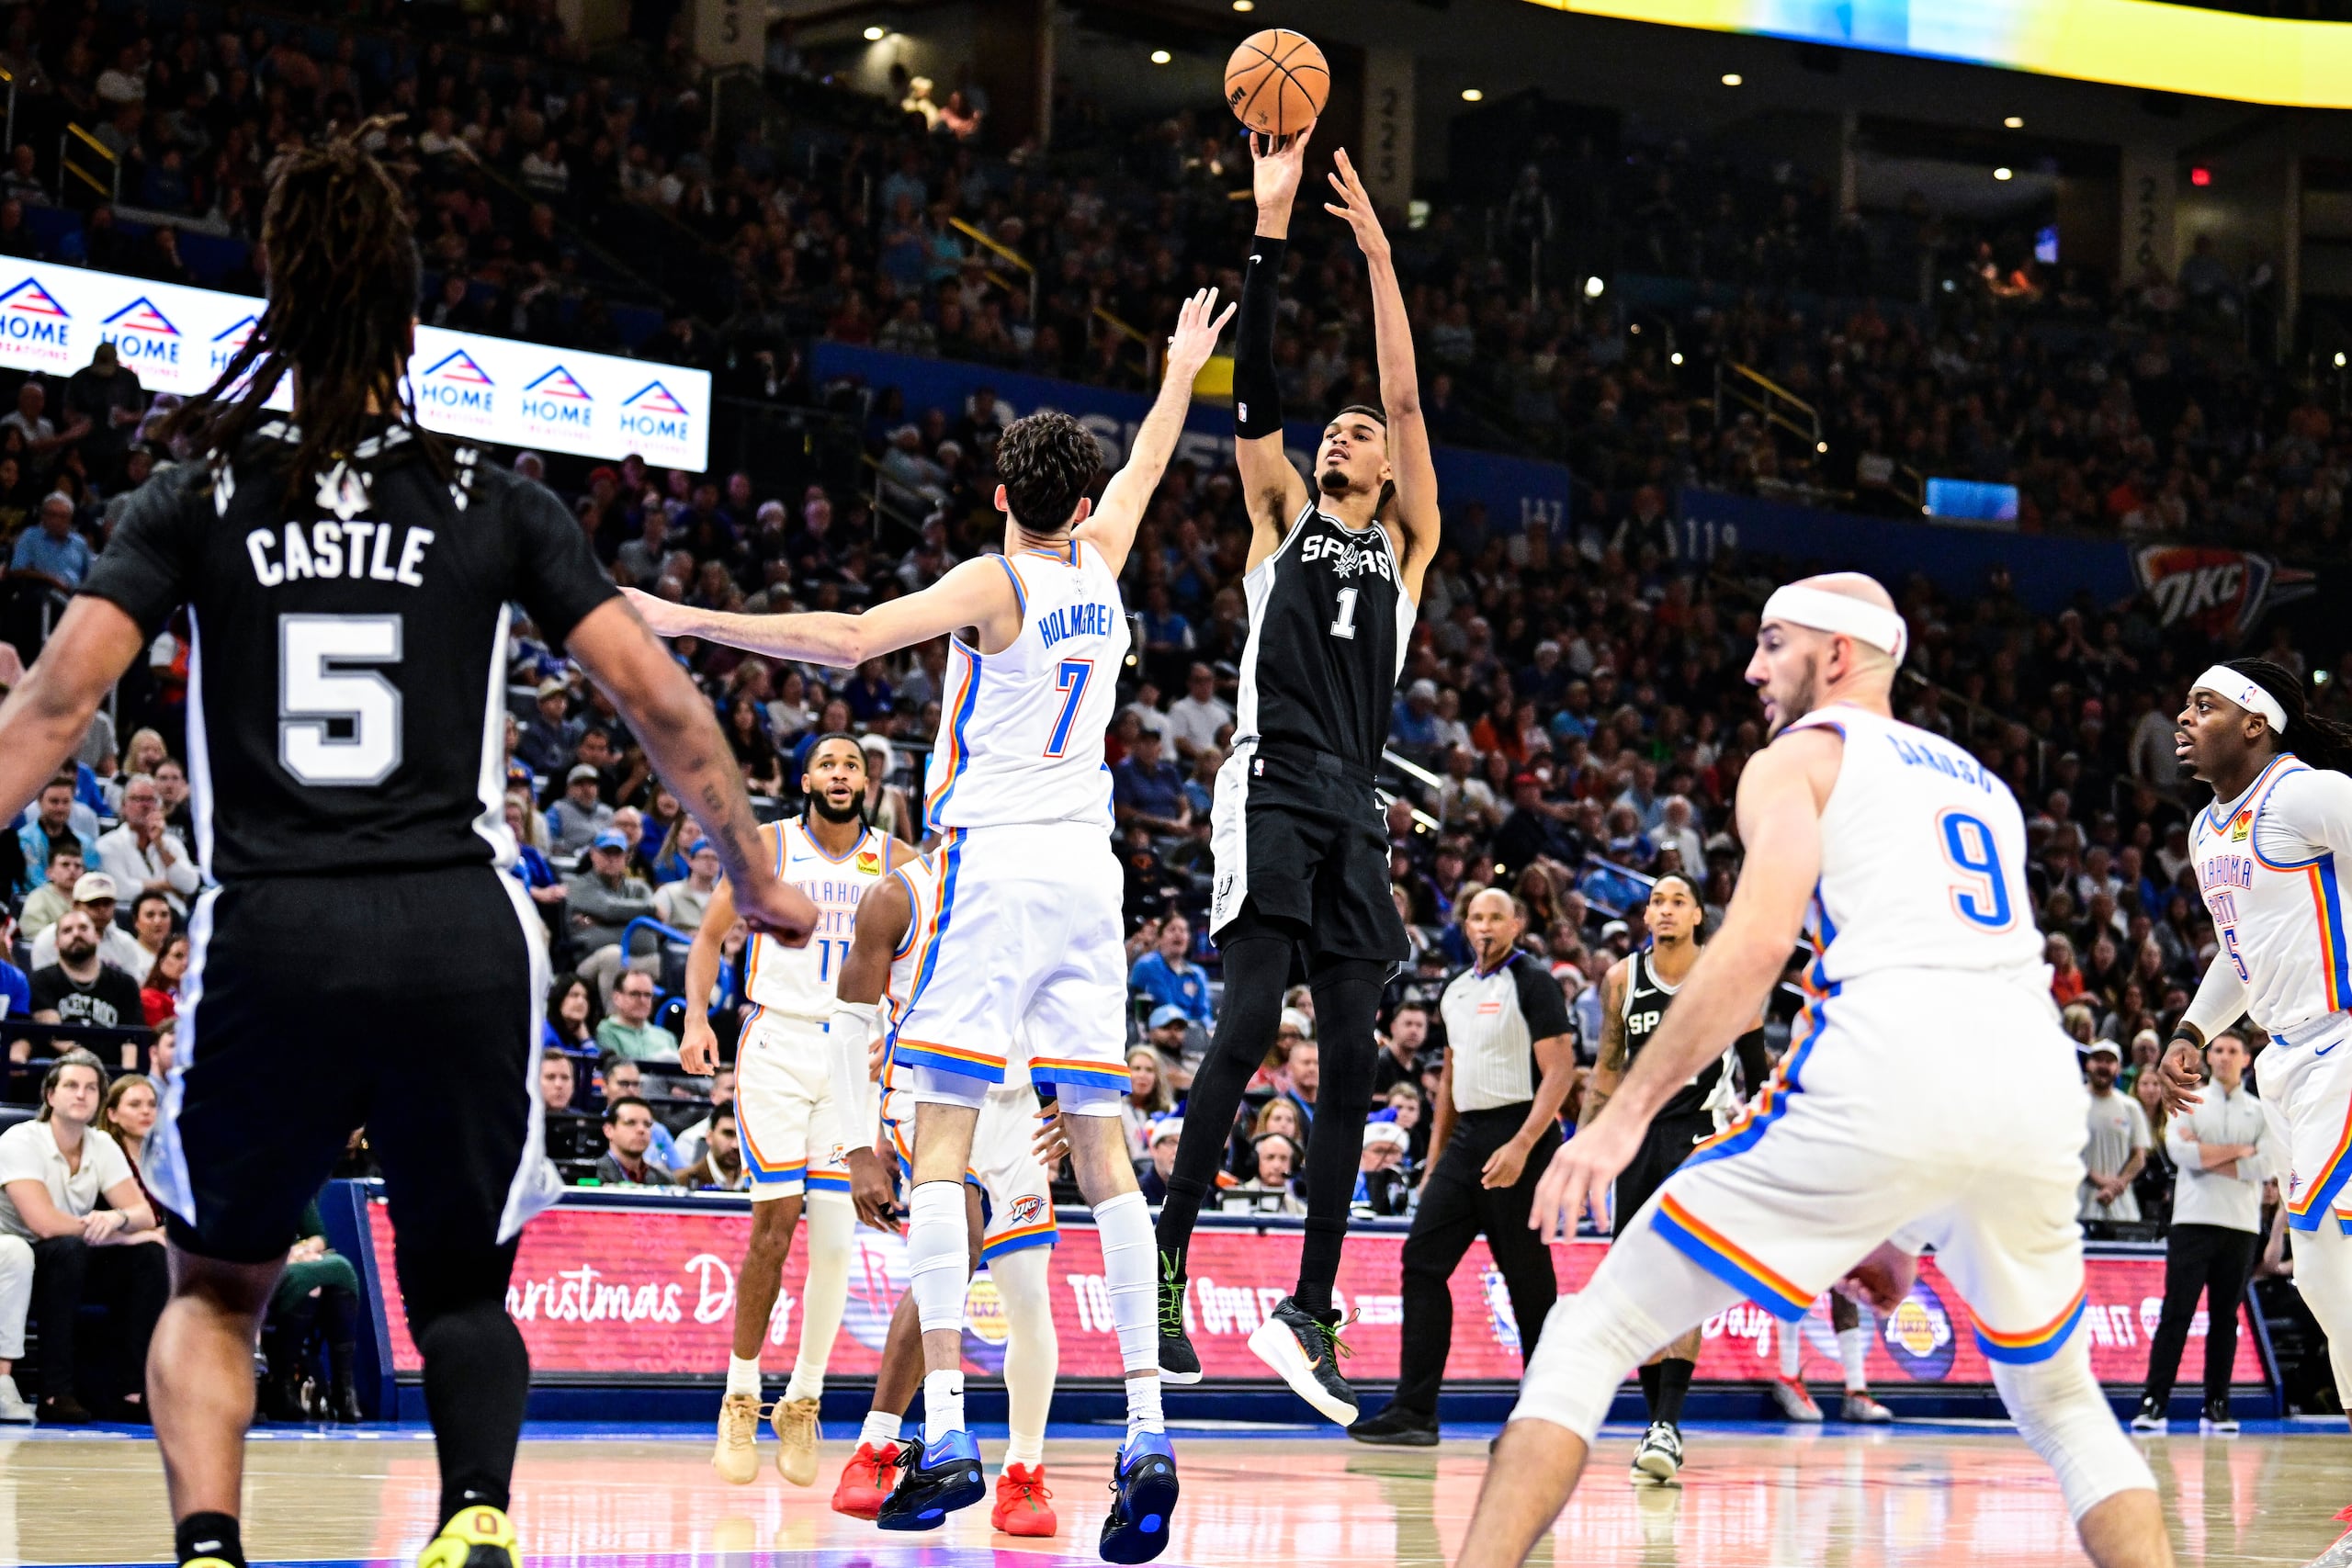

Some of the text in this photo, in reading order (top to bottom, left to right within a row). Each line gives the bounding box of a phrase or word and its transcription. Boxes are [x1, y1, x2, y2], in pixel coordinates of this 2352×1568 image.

[422, 383, 493, 412] HOME
[521, 398, 592, 427] HOME
[619, 412, 688, 442] HOME
[245, 521, 435, 588] CASTLE
[1301, 535, 1391, 581] SPURS
[1330, 587, 1358, 640] 1
[278, 613, 403, 787] 5
[1043, 658, 1094, 758] 7
[1935, 806, 2018, 935] 9
[2222, 924, 2251, 984] 5
[684, 1253, 796, 1346] Dy
